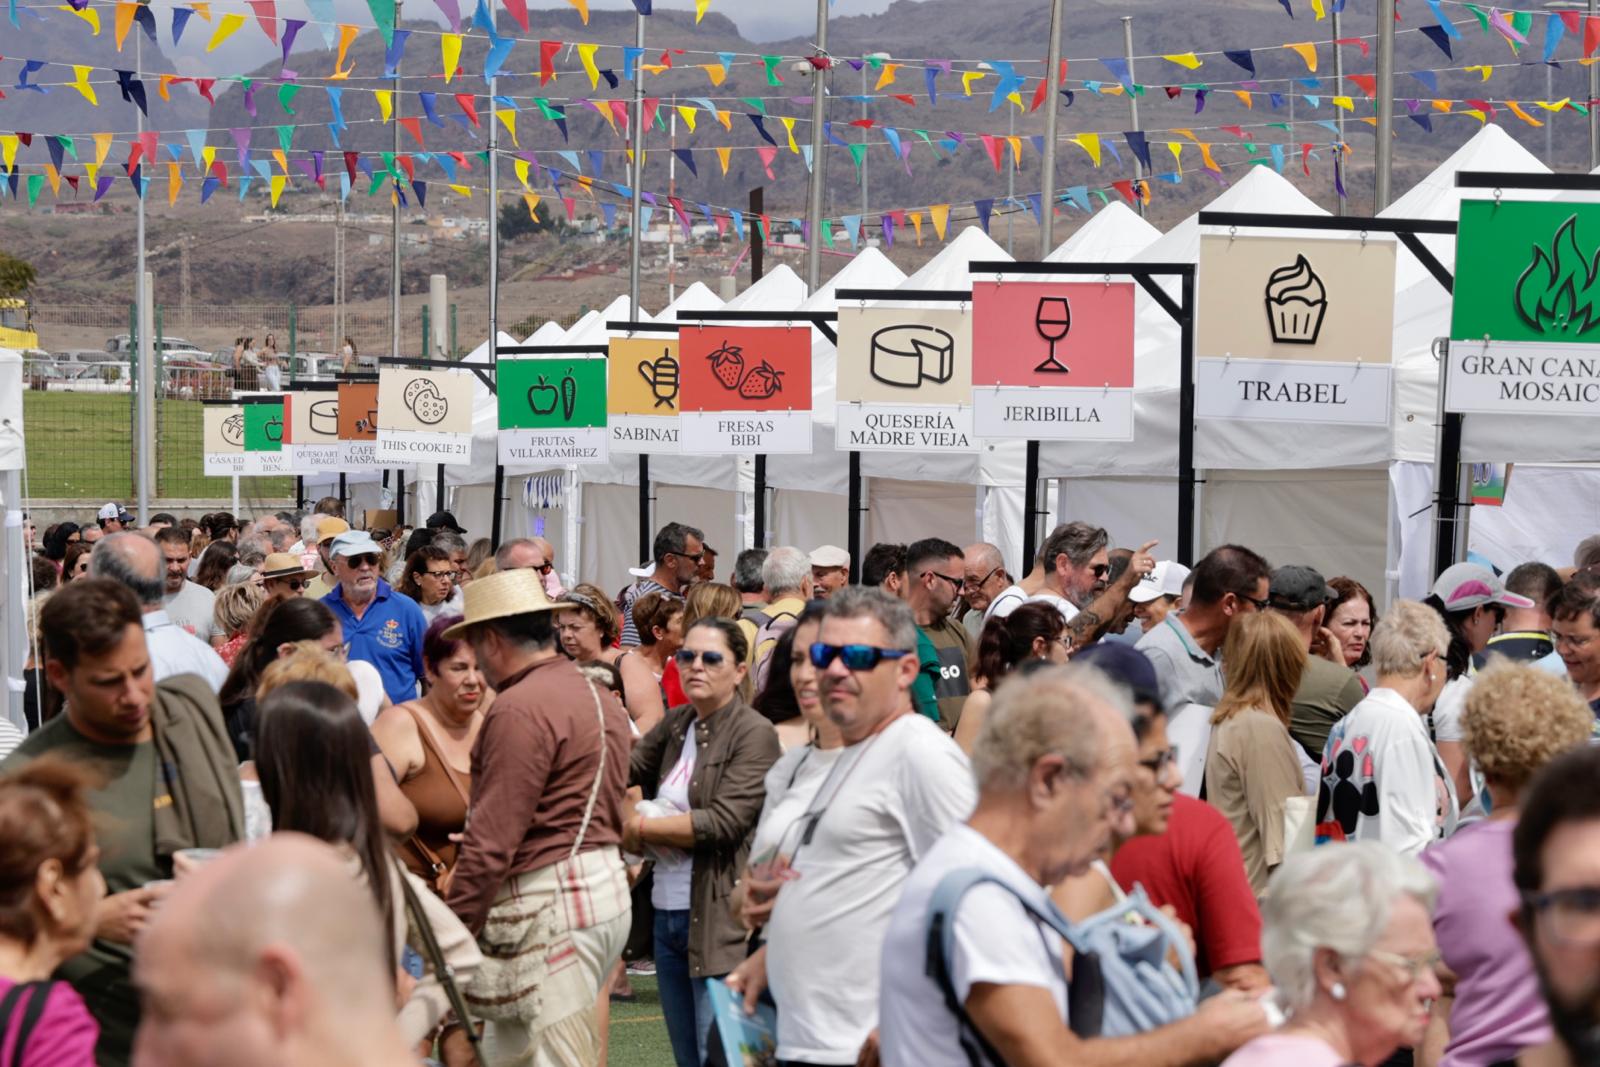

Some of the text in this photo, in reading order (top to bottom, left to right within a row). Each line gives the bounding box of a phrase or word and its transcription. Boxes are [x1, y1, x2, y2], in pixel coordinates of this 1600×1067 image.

[1461, 355, 1600, 378] GRAN CAN
[1238, 380, 1347, 404] TRABEL
[1500, 381, 1600, 402] MOSAIC
[865, 411, 954, 430] QUESERÍA
[1004, 405, 1101, 423] JERIBILLA
[718, 420, 774, 433] FRESAS
[531, 436, 576, 447] FRUTAS
[731, 434, 761, 447] BIBI
[850, 430, 970, 447] MADRE VIEJA
[350, 446, 376, 455] CAFE
[381, 440, 466, 454] THIS COOKIE 21
[509, 446, 598, 458] VILLARAMÍREZ
[297, 451, 323, 459] QUESO
